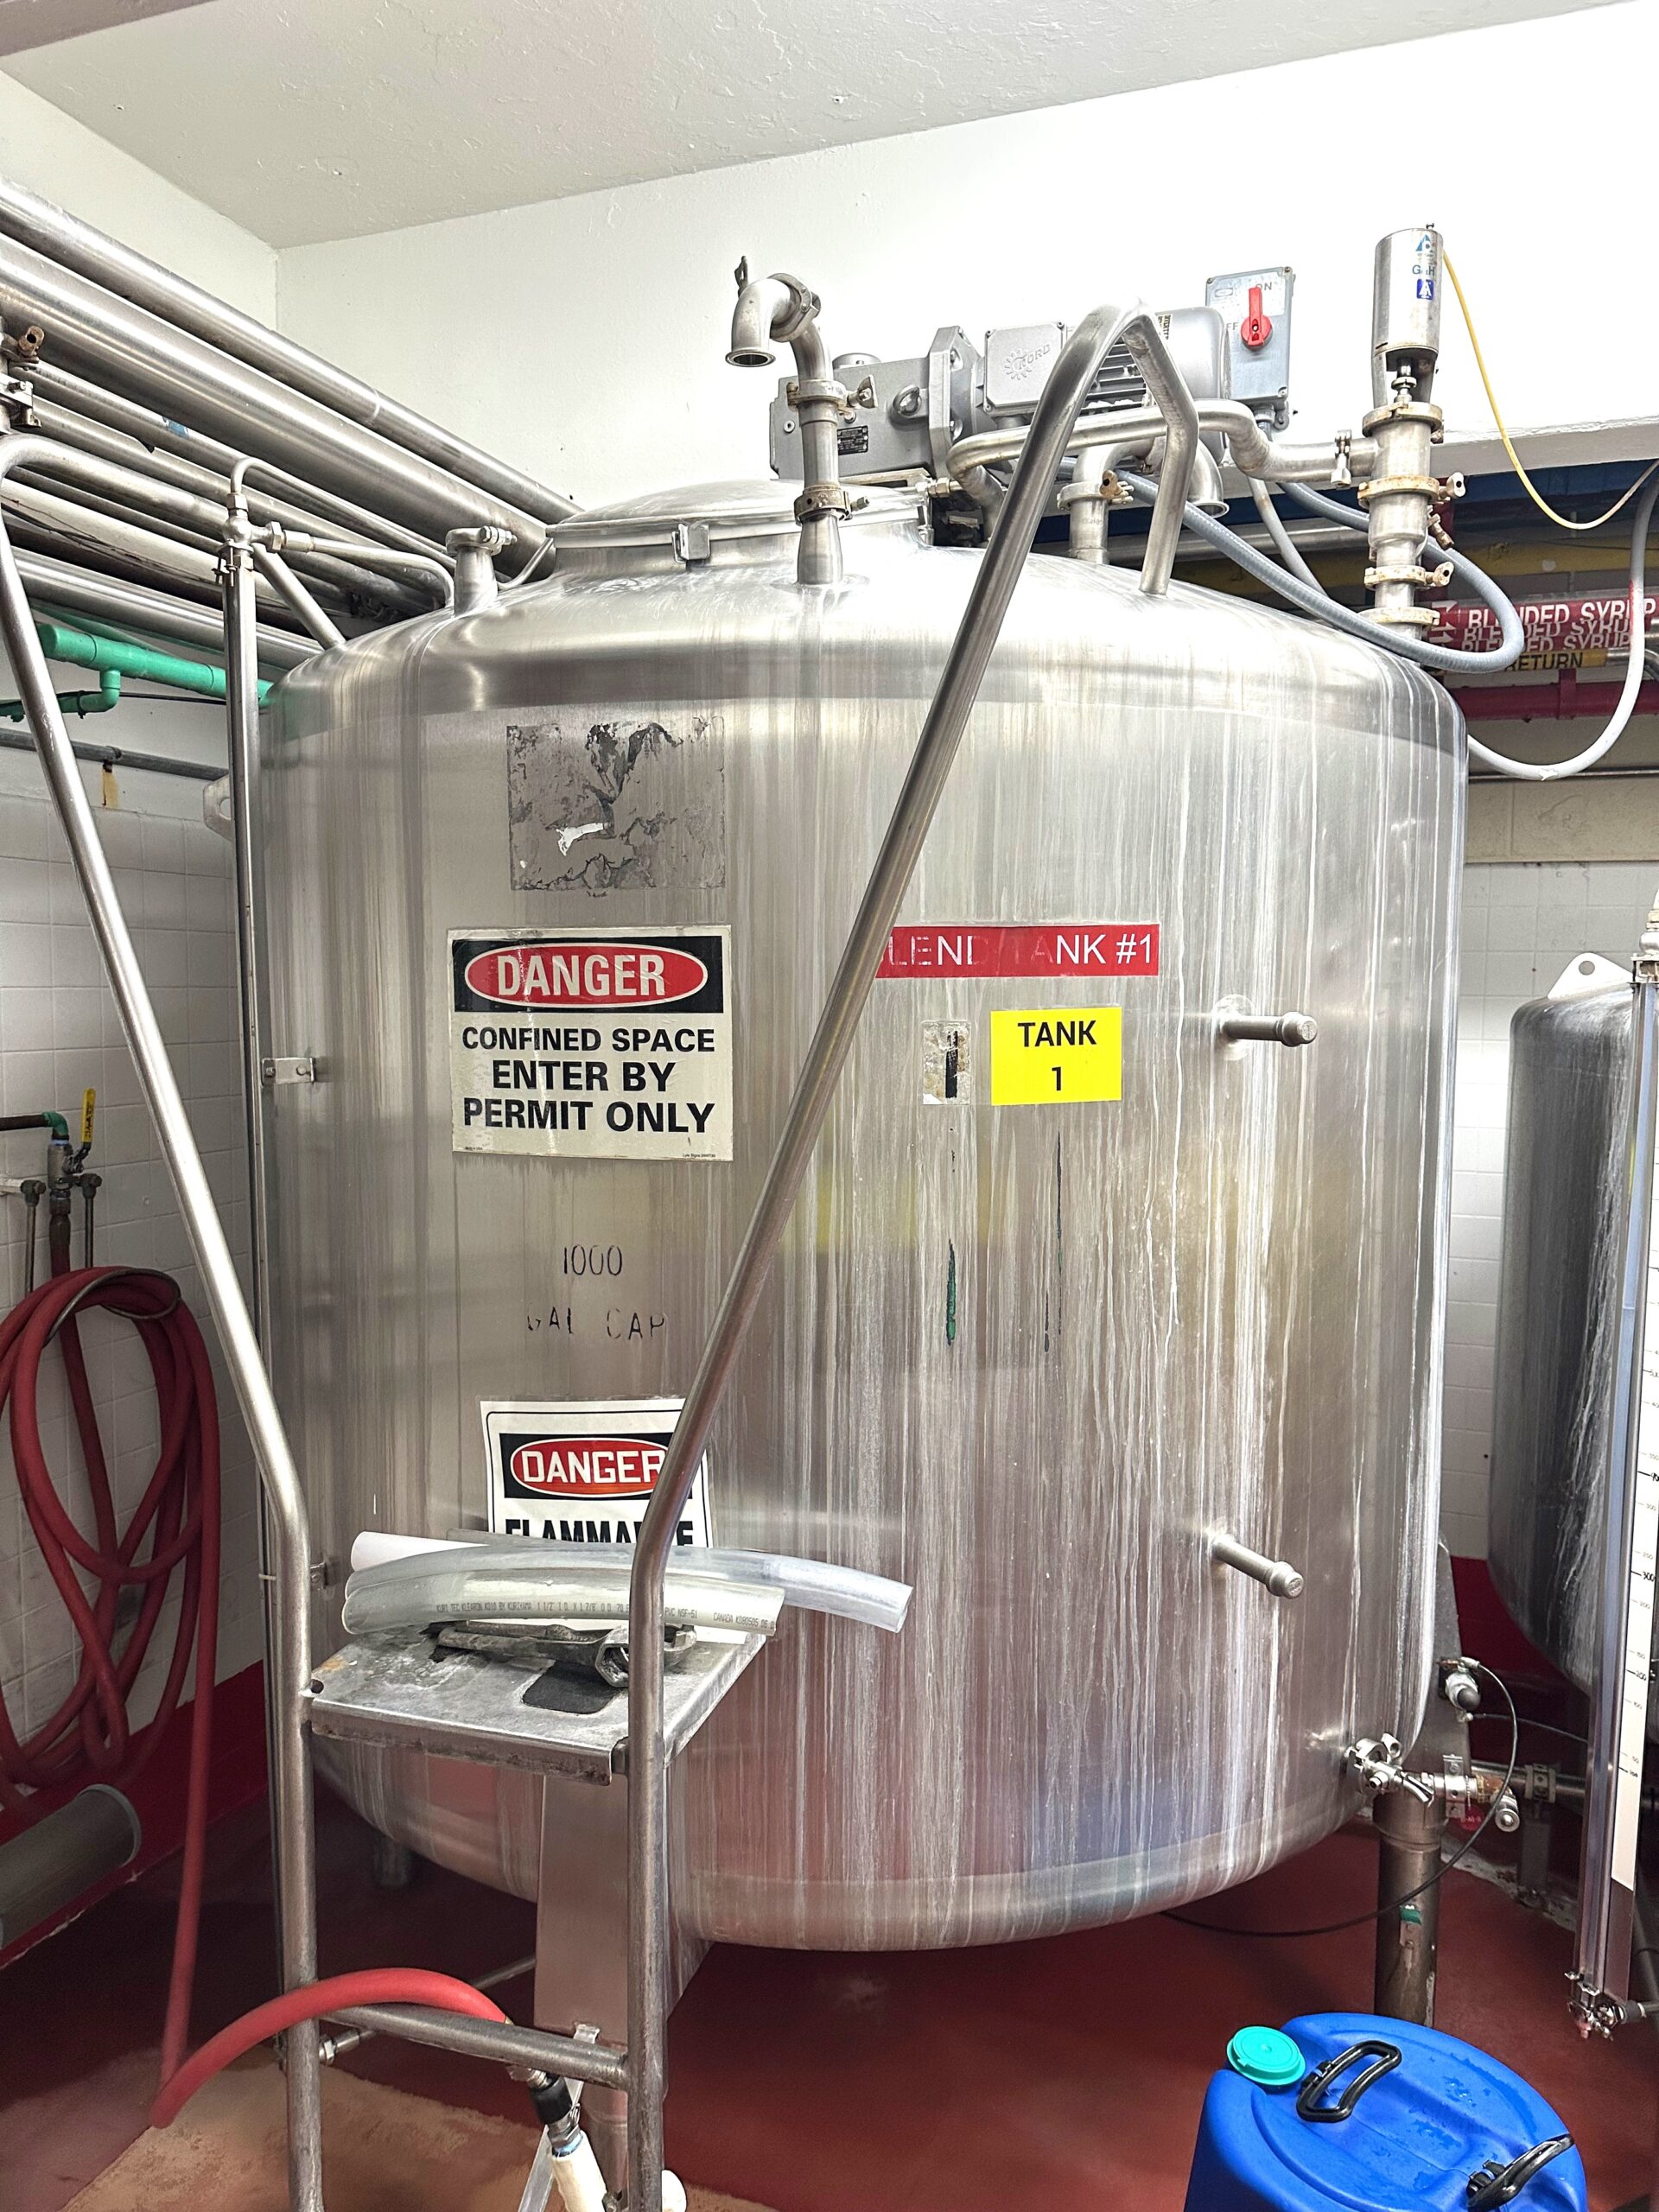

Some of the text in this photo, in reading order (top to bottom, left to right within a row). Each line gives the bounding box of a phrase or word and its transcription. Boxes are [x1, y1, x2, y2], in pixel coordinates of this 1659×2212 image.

[1469, 598, 1656, 629] BLDED SYRP
[1116, 932, 1152, 964] #1
[497, 953, 665, 997] DANGER
[462, 1026, 715, 1052] CONFINED SPACE
[1018, 1020, 1097, 1047] TANK
[493, 1059, 676, 1092] ENTER BY
[1052, 1066, 1063, 1091] 1
[464, 1097, 715, 1134] PERMIT ONLY
[563, 1244, 622, 1276] 1000
[521, 1450, 665, 1484] DANGER
